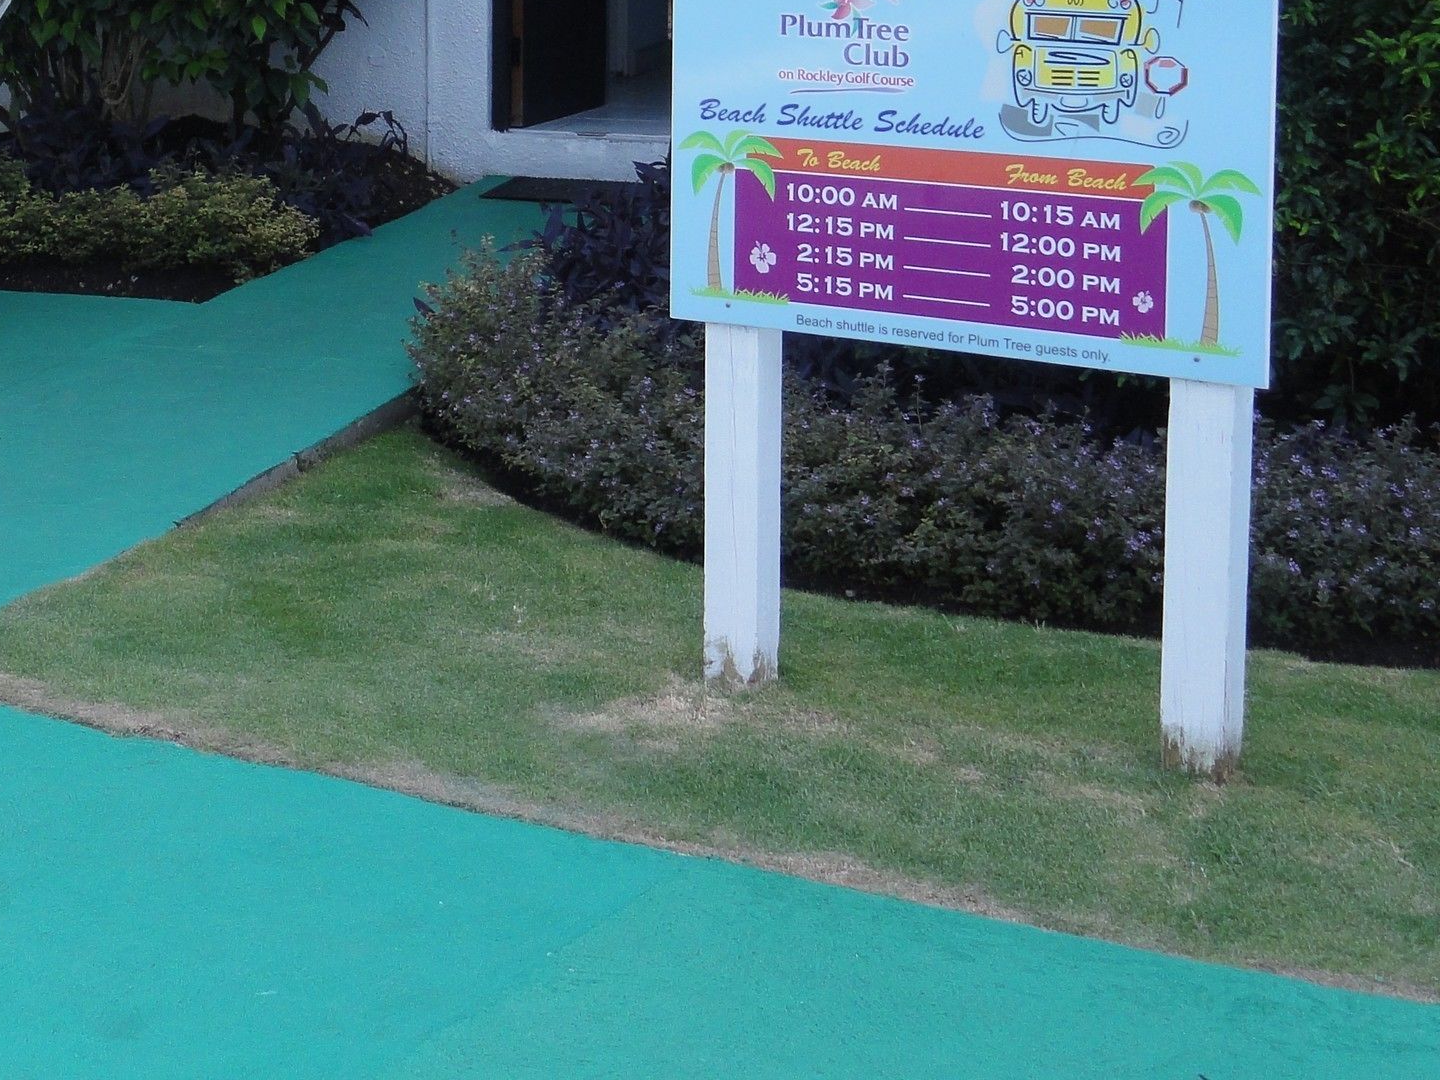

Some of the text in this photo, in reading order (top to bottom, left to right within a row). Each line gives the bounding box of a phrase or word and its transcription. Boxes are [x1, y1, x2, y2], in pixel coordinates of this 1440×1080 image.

[844, 43, 909, 67] Club
[779, 69, 914, 87] on Rockley Golf Course
[699, 98, 985, 139] Beach Shuttle Schedule
[797, 148, 881, 172] To Beach
[1005, 163, 1127, 191] From Beach
[787, 183, 898, 211] 10:00 AM
[786, 212, 894, 240] 12:15 PM
[1000, 201, 1120, 231] 10:15 AM
[797, 243, 894, 271] 2:15 PM
[1000, 232, 1121, 262] 12:00 PM
[796, 272, 893, 301] 5:15 PM
[1011, 264, 1120, 294] 2:00 PM
[1011, 295, 1120, 326] 5:00 PM
[796, 314, 1111, 363] Beach shuttle is reserved for Plum Tree guests only.
